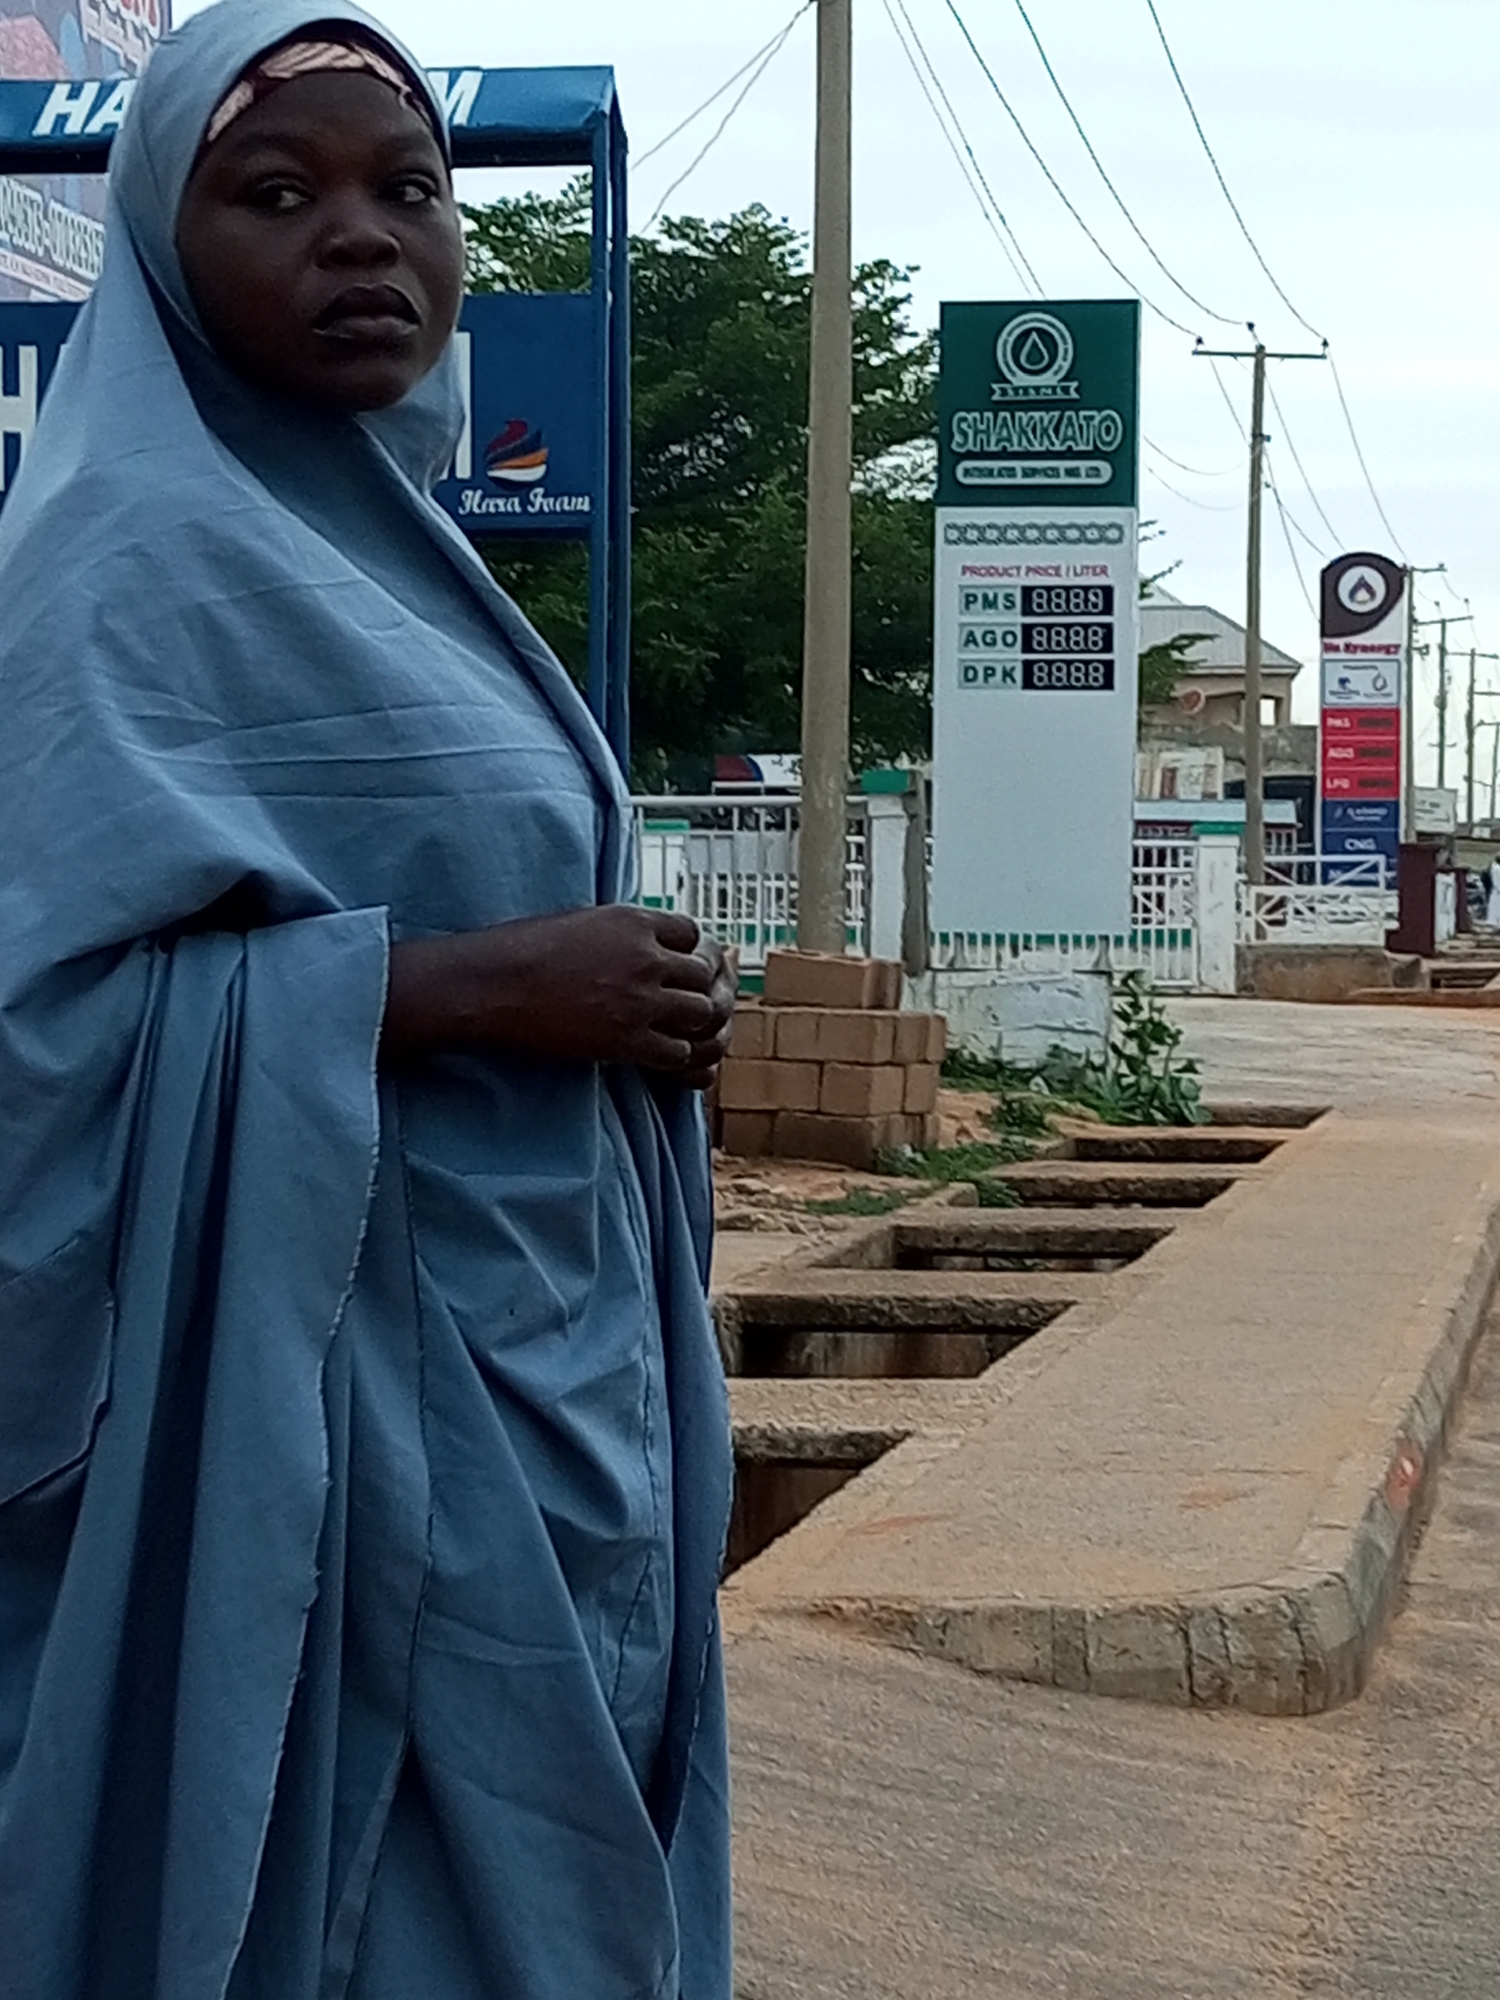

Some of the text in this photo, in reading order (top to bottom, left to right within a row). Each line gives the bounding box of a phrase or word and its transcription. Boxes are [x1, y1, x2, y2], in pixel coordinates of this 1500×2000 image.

[950, 409, 1123, 452] SHAKKATO
[961, 565, 1021, 578] PRODUCT
[1025, 565, 1062, 578] PRICE
[1073, 565, 1110, 578] LITER
[964, 592, 1017, 611] PMS
[963, 629, 1018, 648] AGO
[963, 665, 1017, 684] DPK
